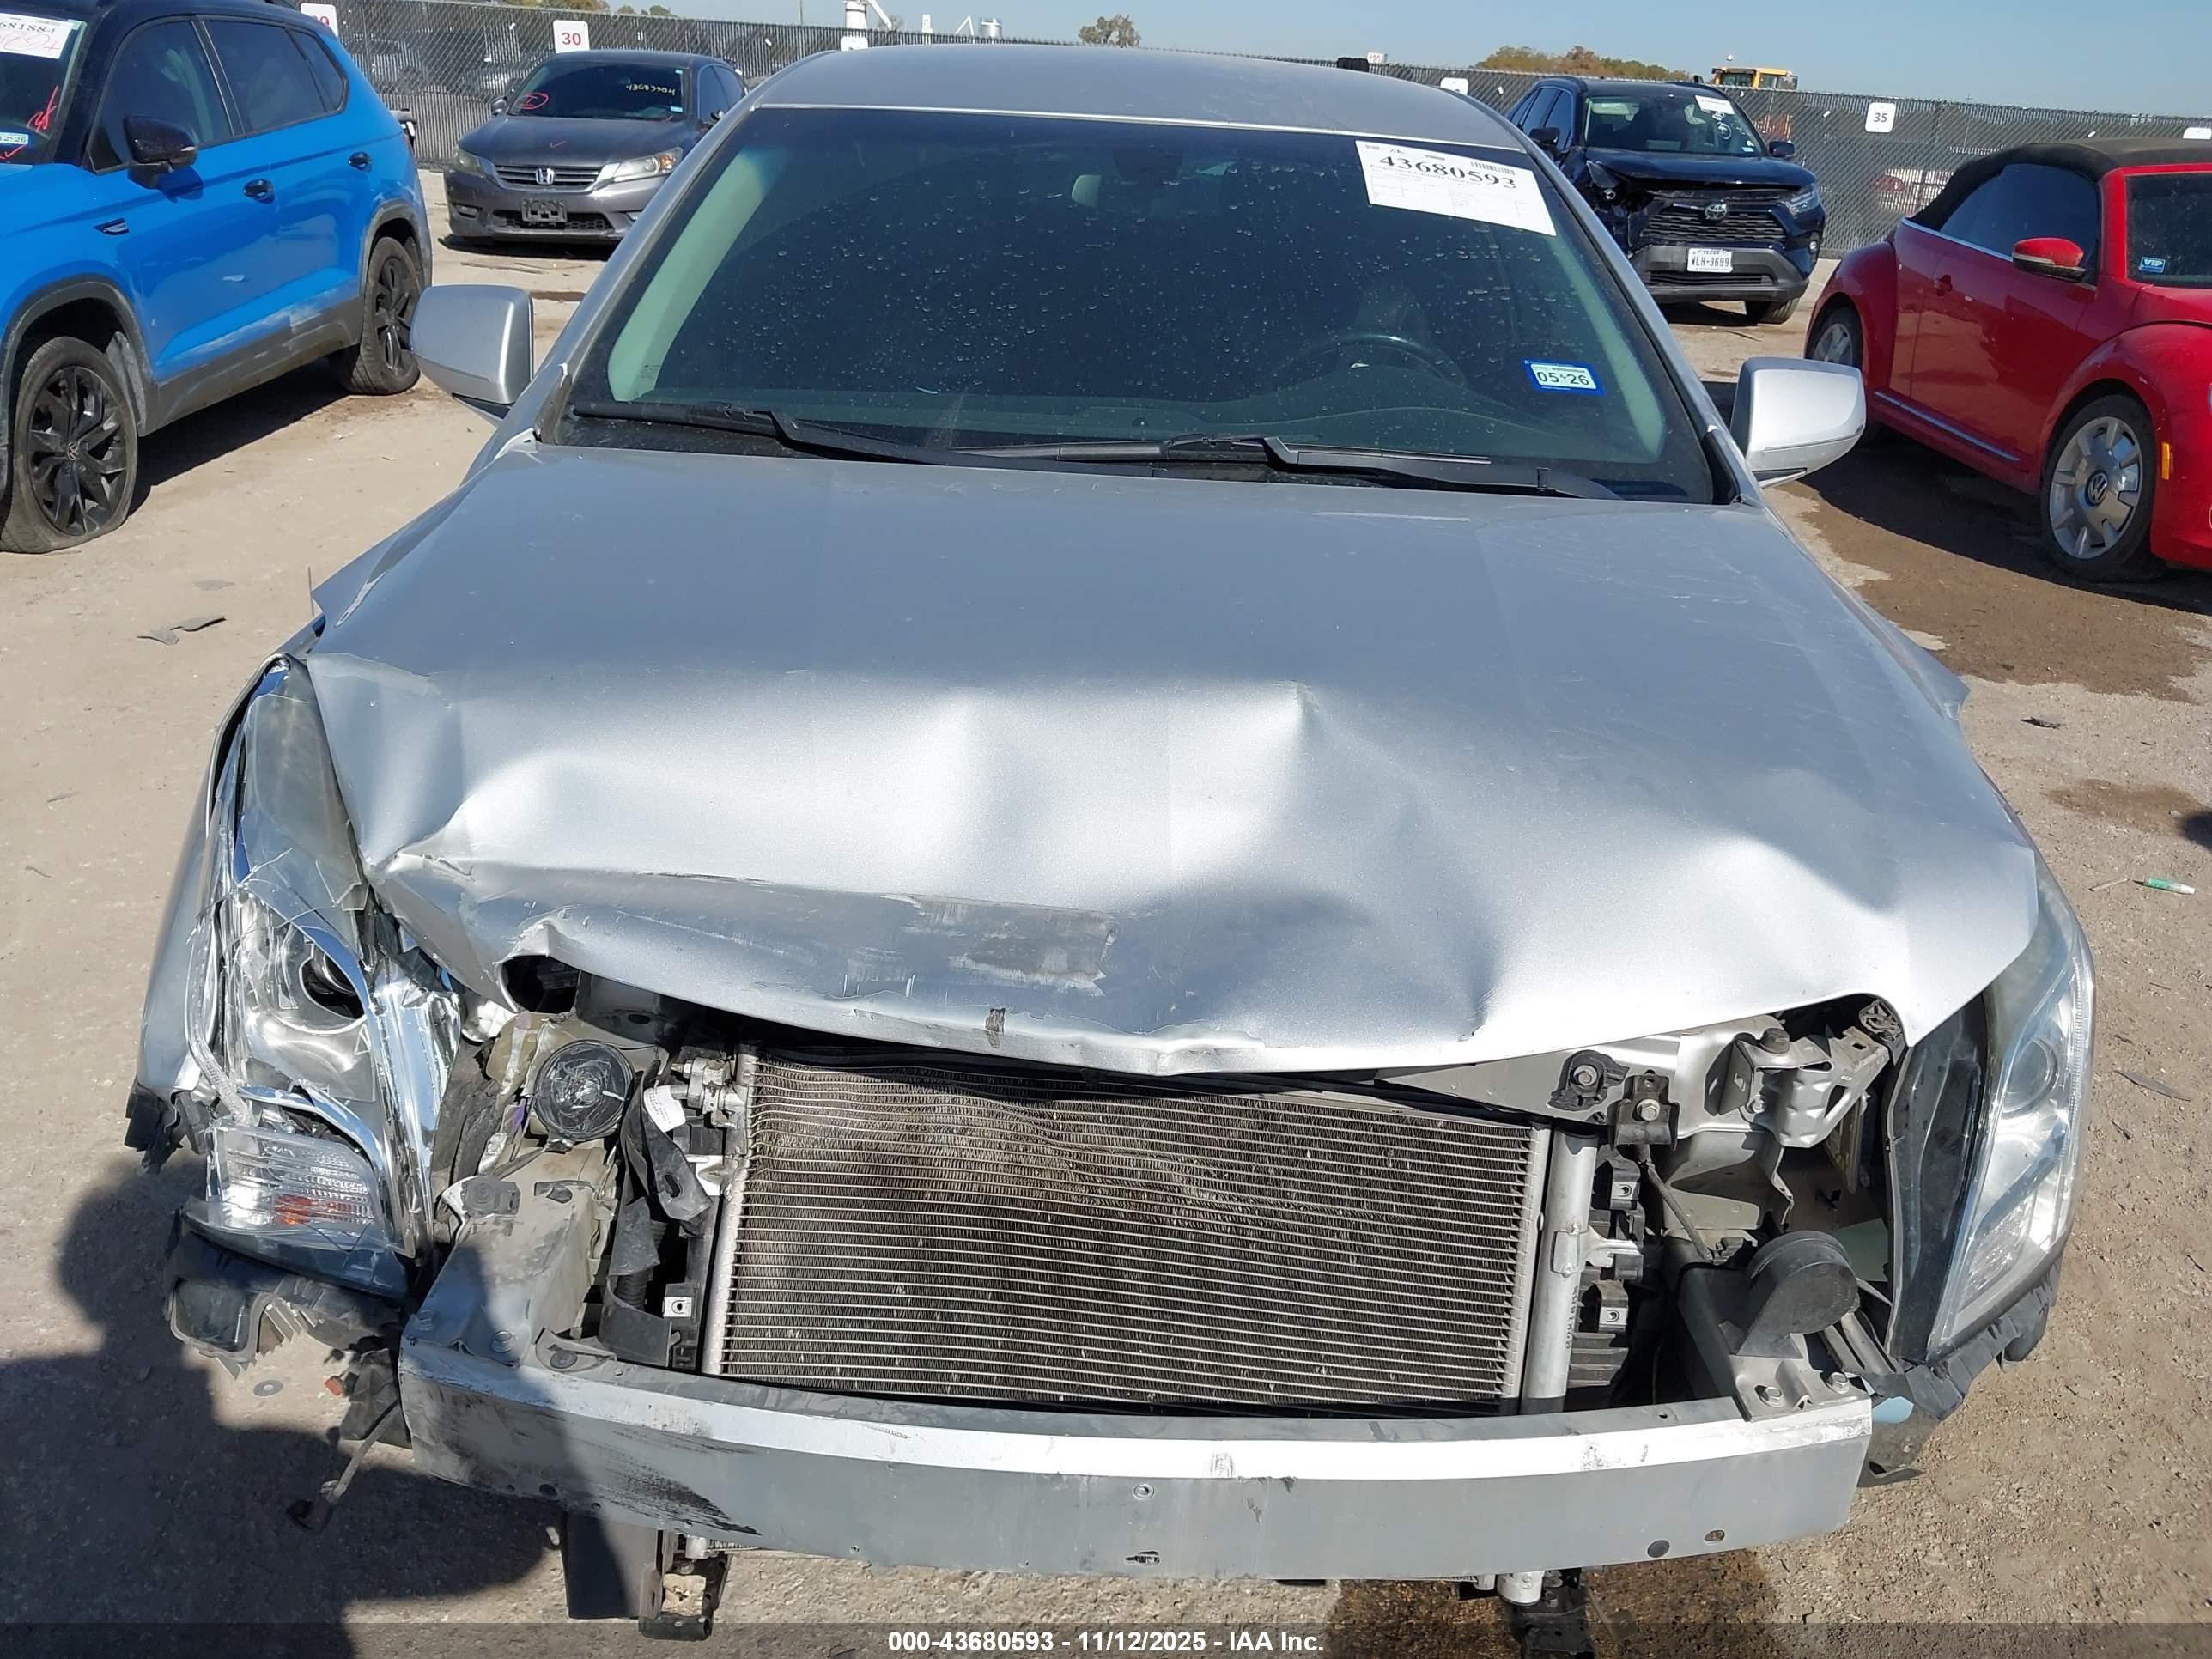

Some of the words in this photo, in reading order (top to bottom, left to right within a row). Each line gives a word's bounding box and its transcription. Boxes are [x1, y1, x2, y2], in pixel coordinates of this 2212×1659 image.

[562, 32, 581, 46] 30
[1873, 112, 1887, 123] 35
[1379, 155, 1517, 189] 43680593
[1691, 256, 1729, 267] WLH-9699
